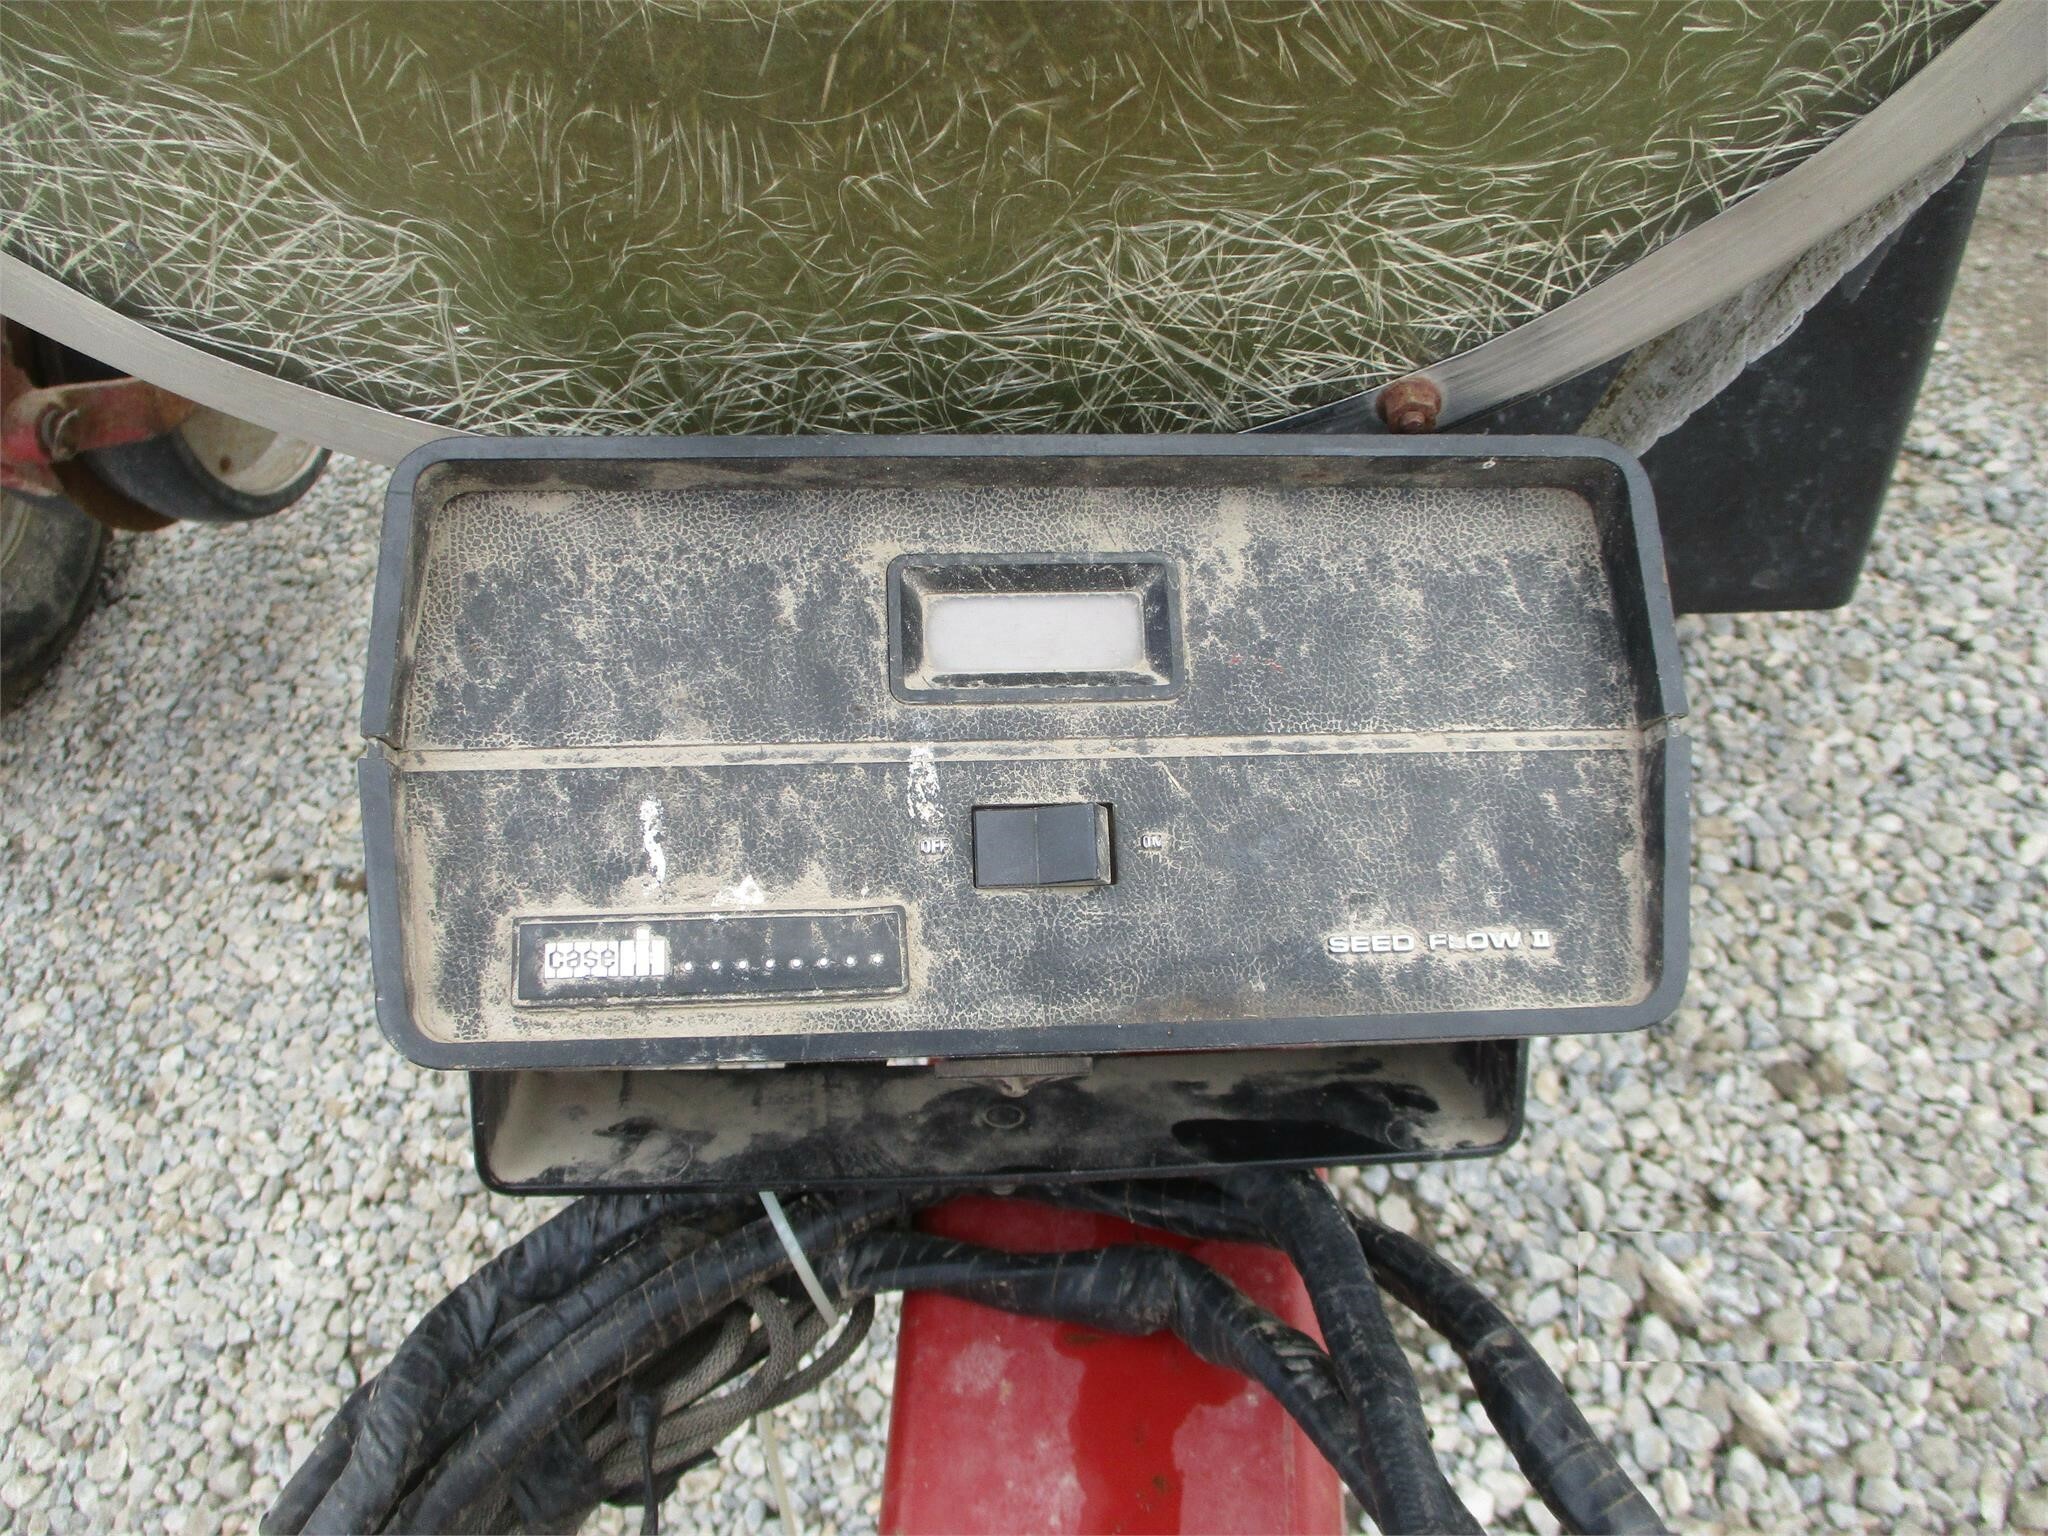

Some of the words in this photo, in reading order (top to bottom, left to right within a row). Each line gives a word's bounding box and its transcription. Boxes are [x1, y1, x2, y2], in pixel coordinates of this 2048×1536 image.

[920, 838, 950, 853] OFF
[1141, 834, 1162, 848] ON
[1328, 935, 1415, 953] SEED
[1427, 931, 1520, 950] FLOW
[546, 946, 617, 972] case
